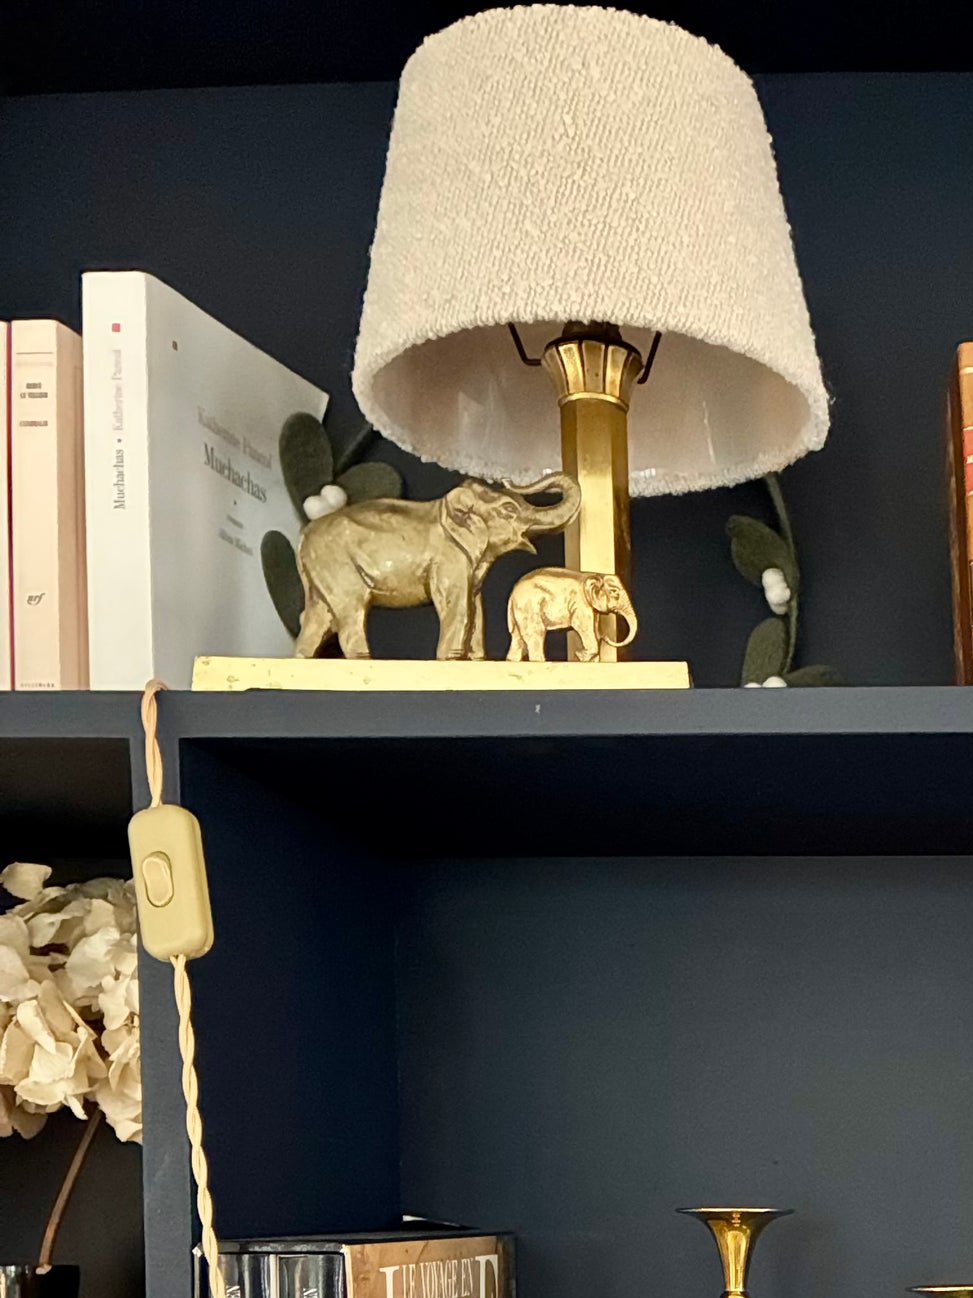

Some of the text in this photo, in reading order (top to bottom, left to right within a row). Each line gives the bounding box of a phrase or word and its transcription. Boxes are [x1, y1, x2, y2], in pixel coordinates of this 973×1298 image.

[113, 448, 126, 511] Muchachas
[204, 441, 268, 504] Muchachas
[460, 1256, 475, 1297] EN
